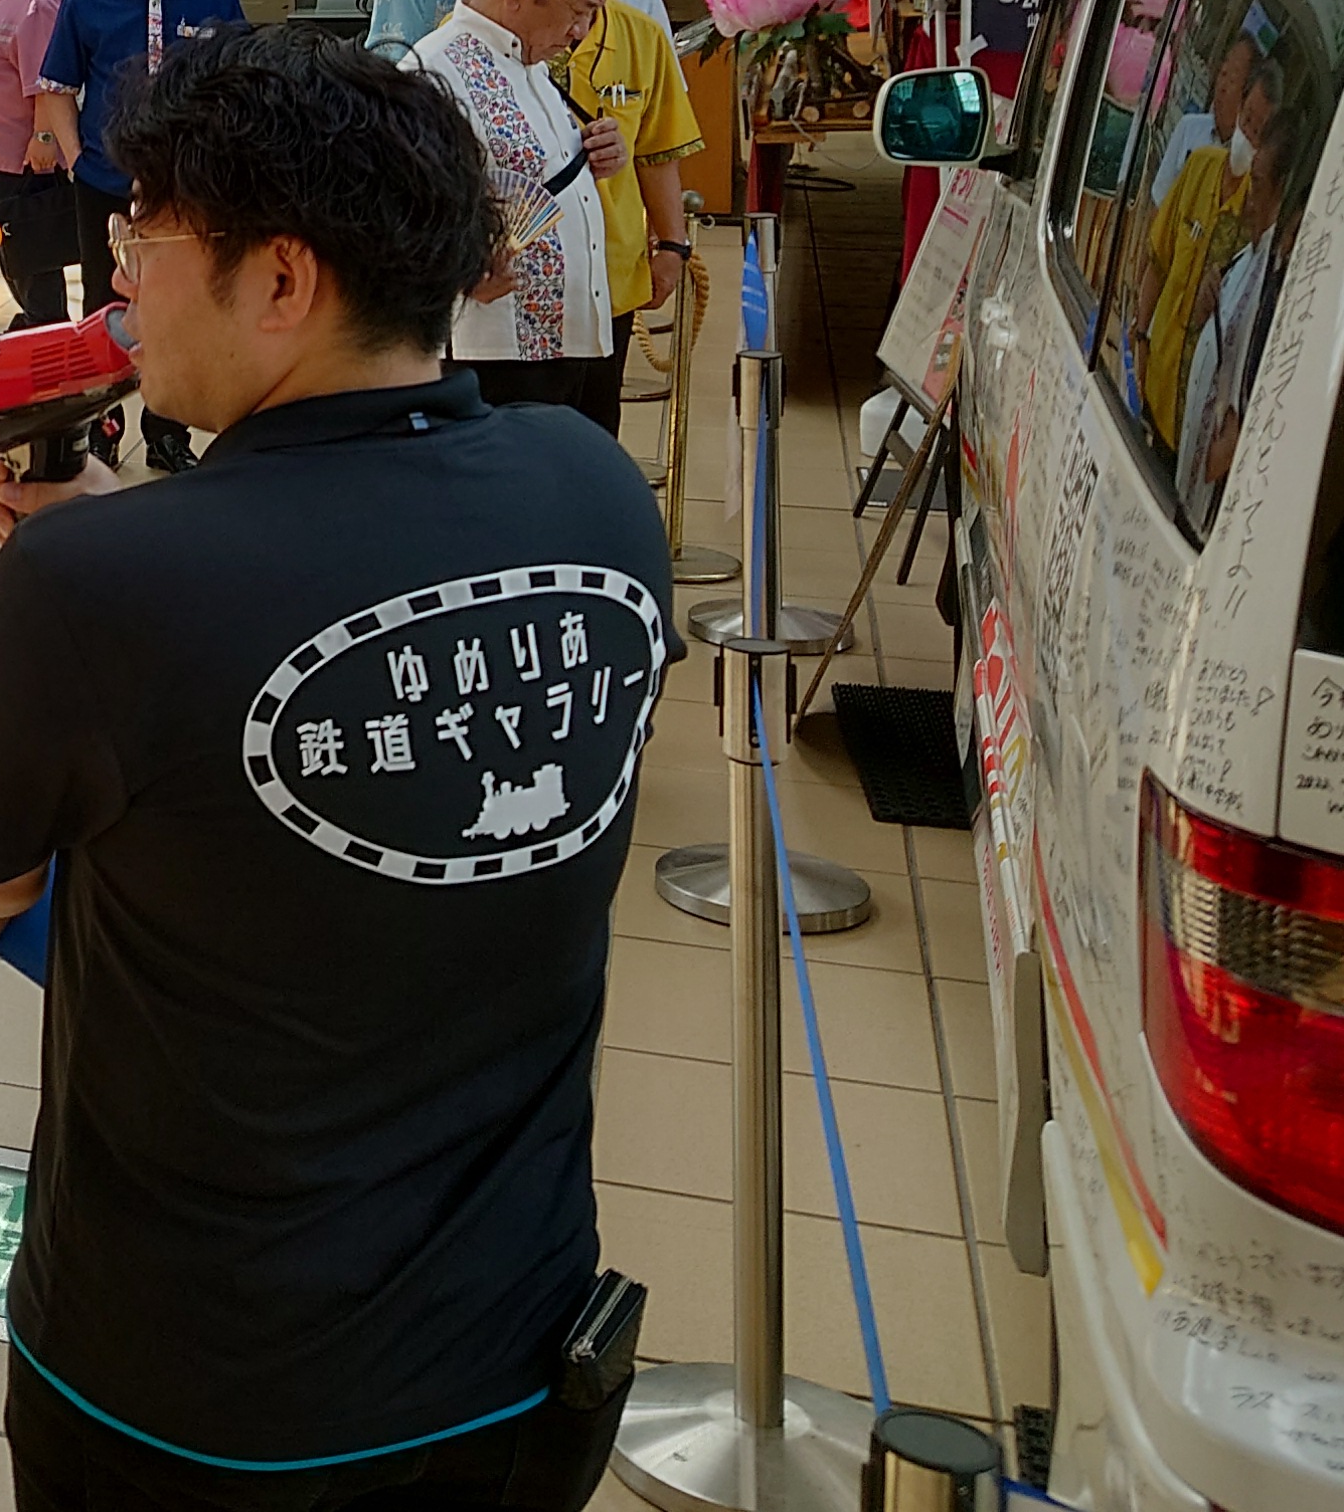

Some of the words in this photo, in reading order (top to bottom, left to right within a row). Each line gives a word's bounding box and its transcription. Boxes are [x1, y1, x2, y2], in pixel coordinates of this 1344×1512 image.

[387, 611, 589, 702] ゆめりあ
[297, 666, 645, 777] 鉄道ギャラリー
